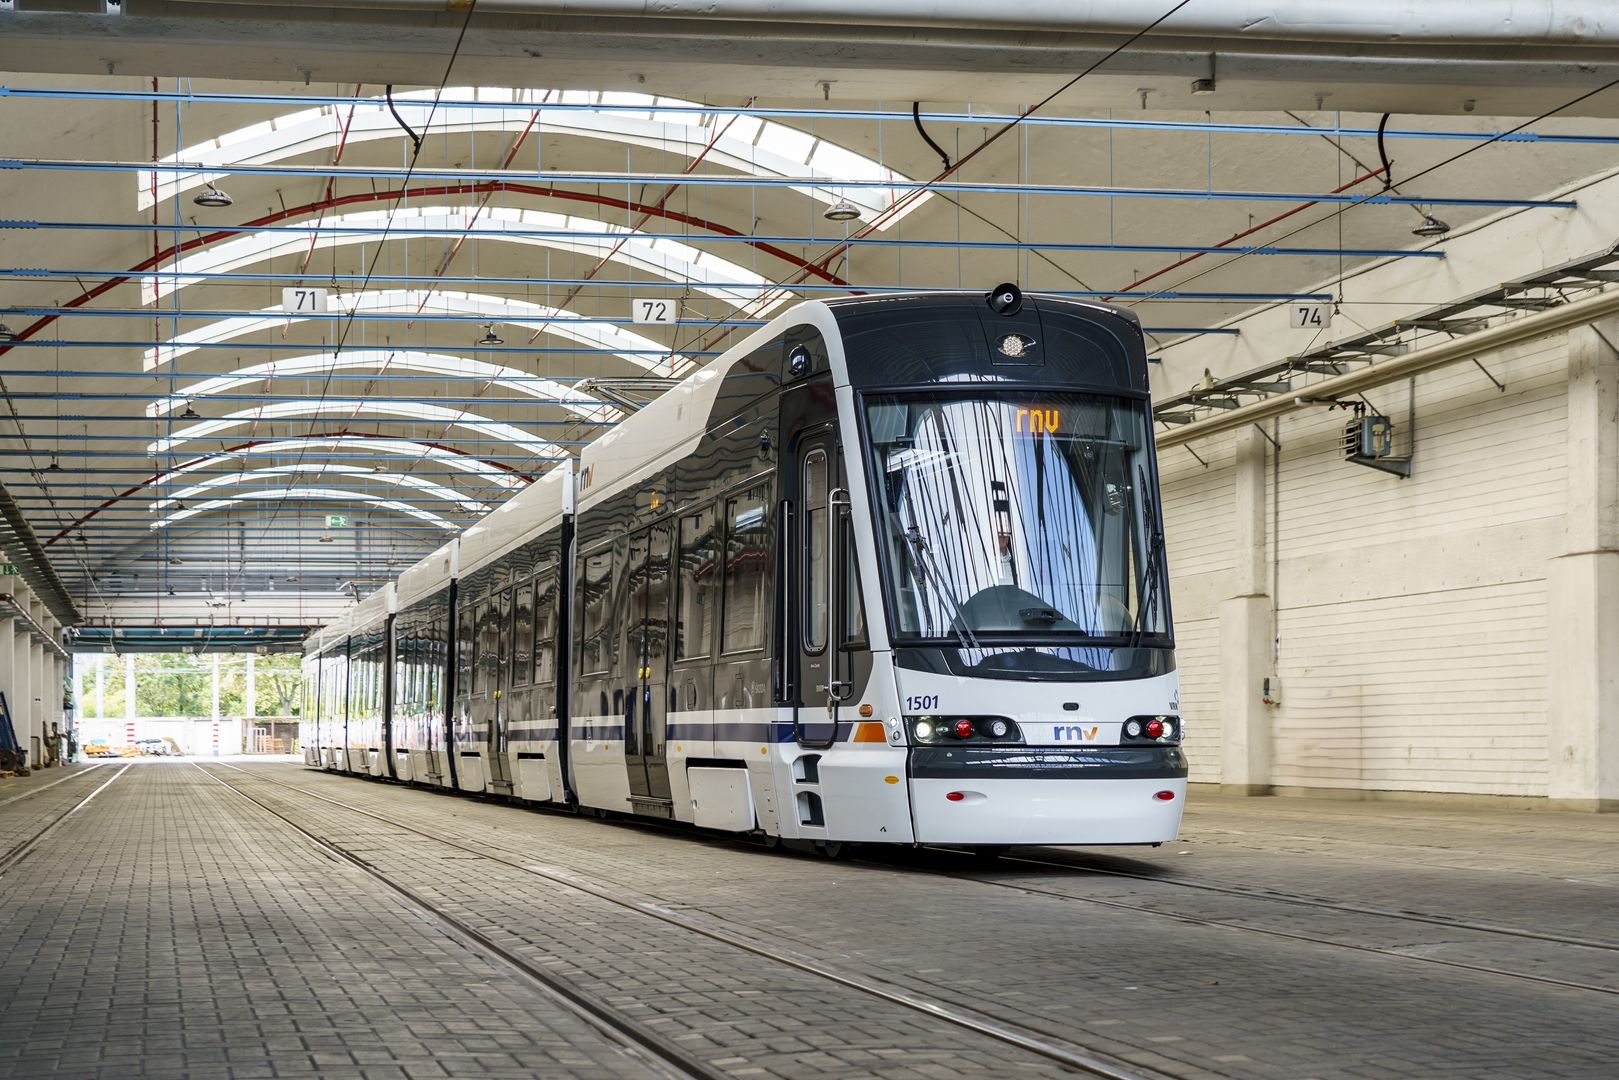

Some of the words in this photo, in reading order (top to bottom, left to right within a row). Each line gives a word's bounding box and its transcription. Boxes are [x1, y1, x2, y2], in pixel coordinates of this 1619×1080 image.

[295, 291, 317, 310] 71
[643, 302, 666, 321] 72
[1298, 308, 1322, 326] 74
[1016, 408, 1059, 433] rnv
[580, 463, 595, 491] rnv
[906, 695, 938, 711] 1501
[1054, 725, 1097, 742] rnv
